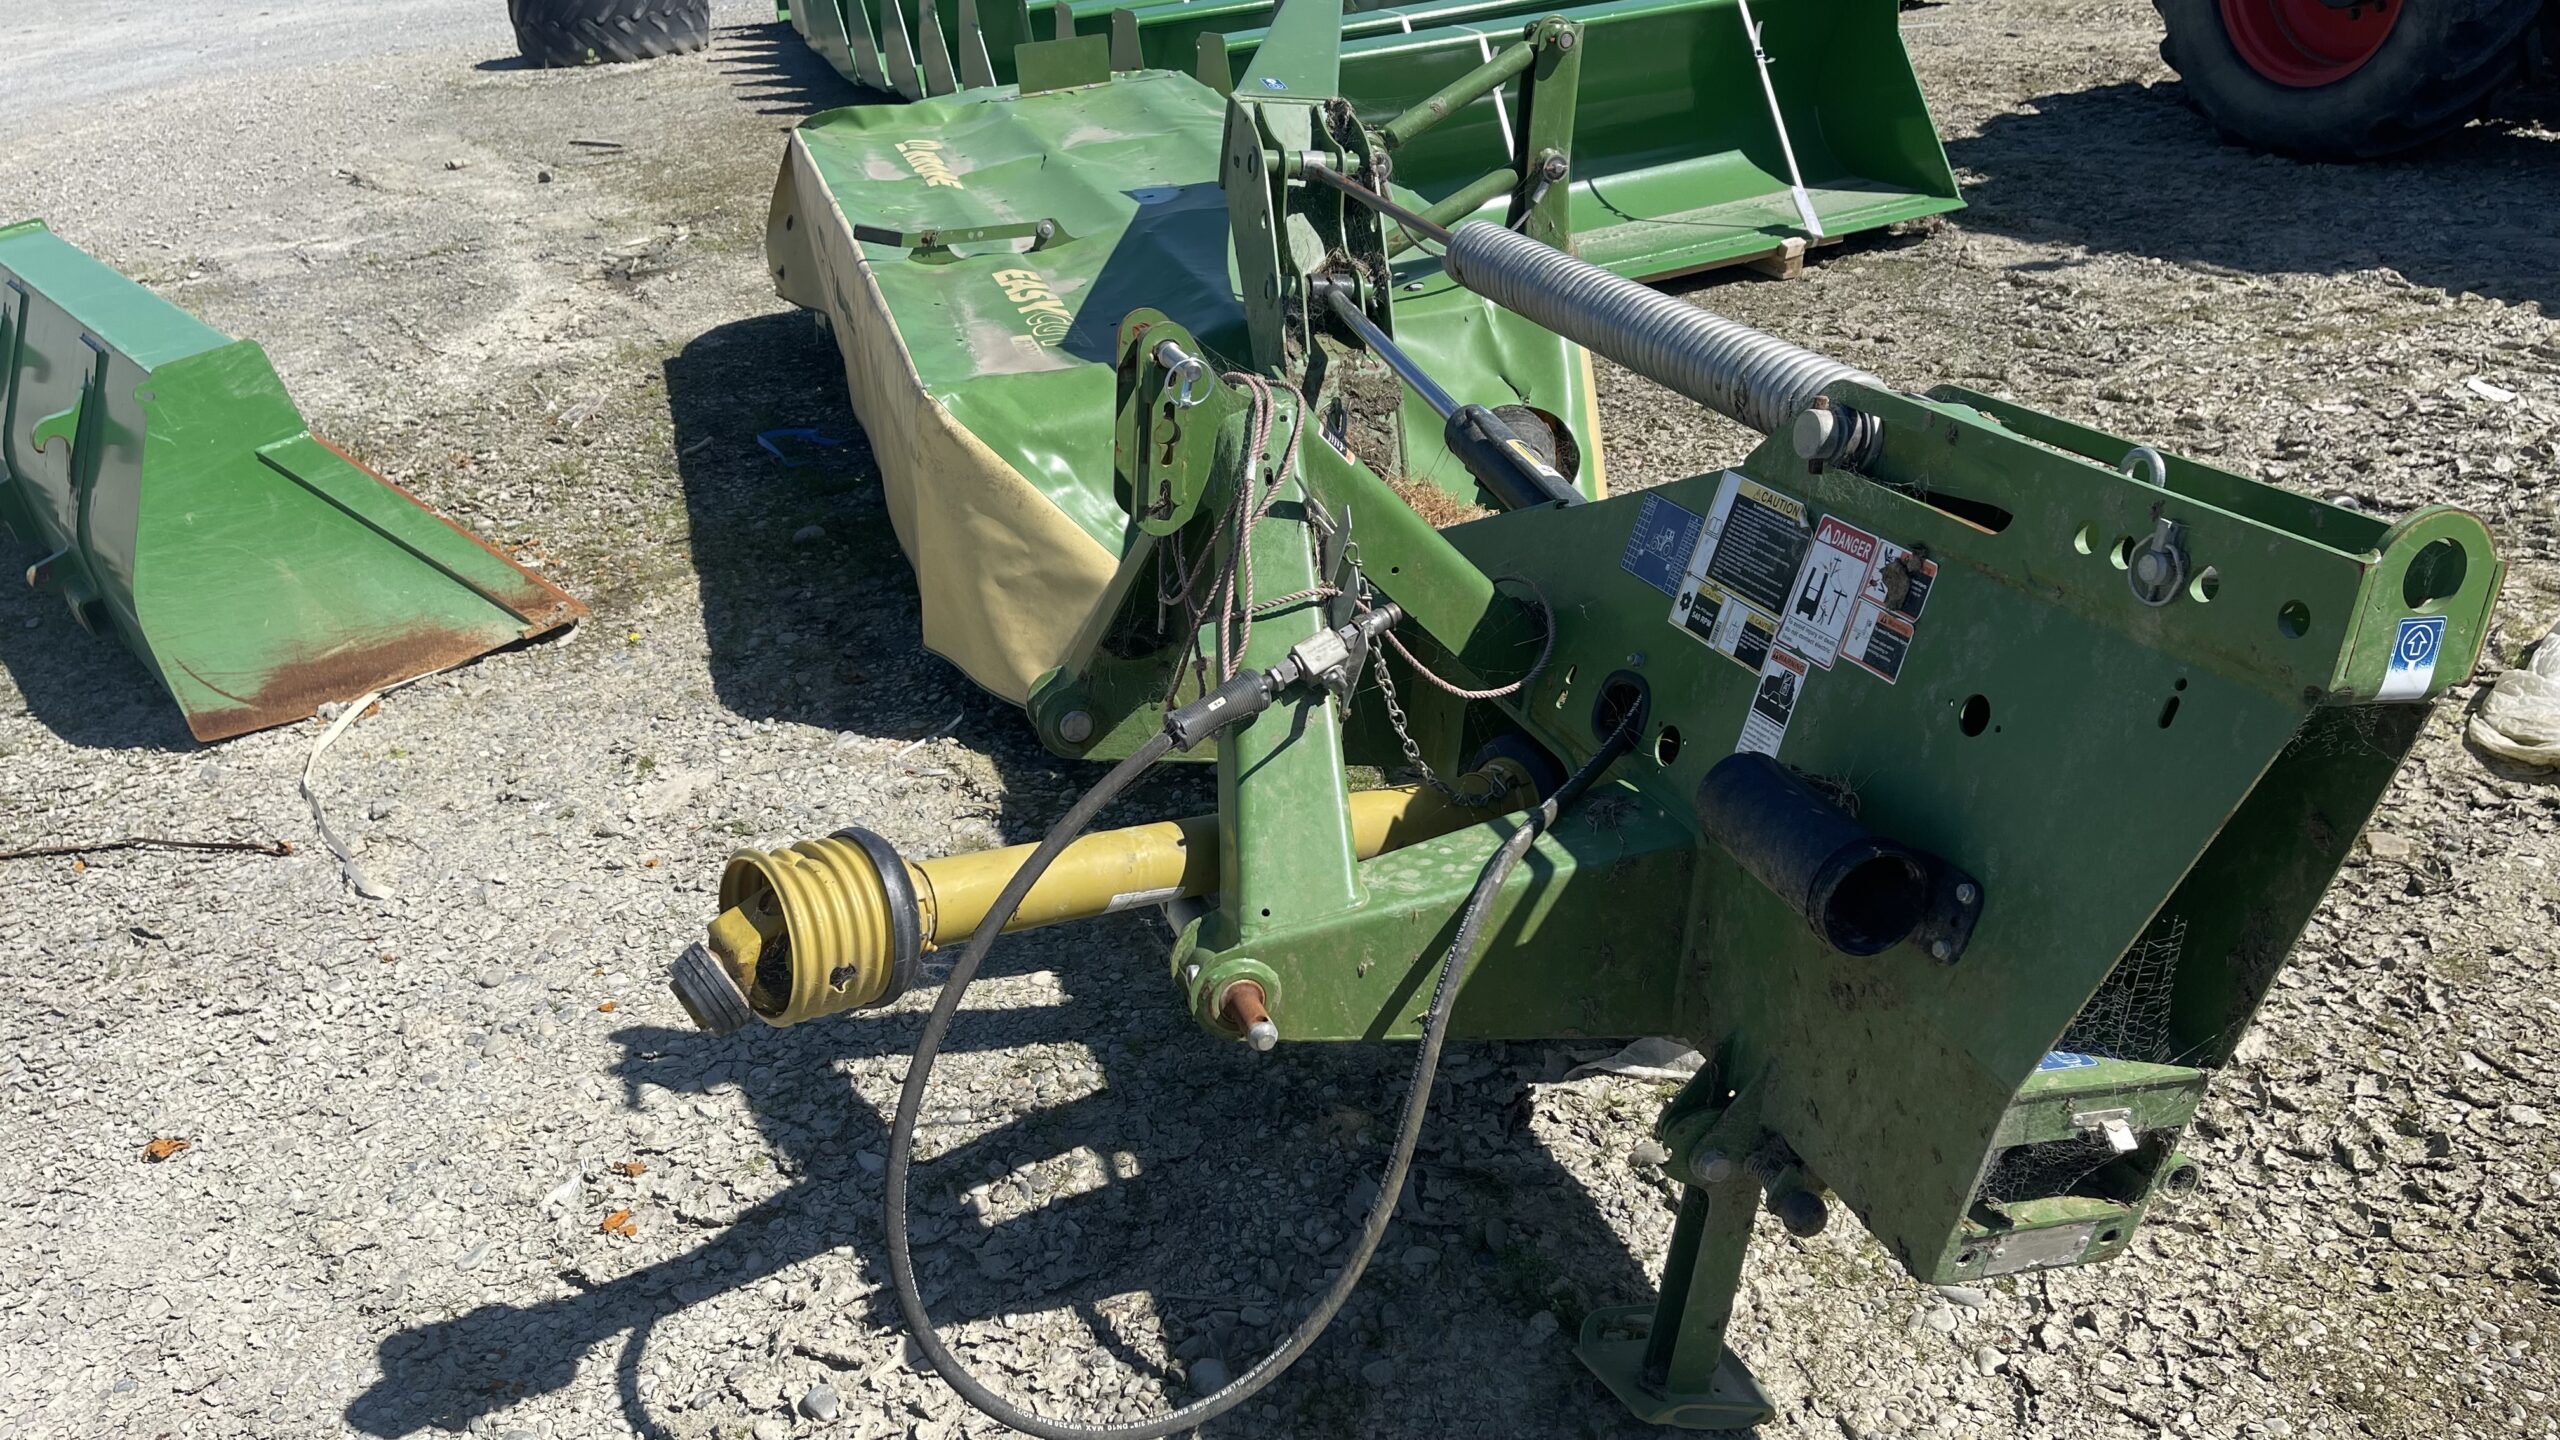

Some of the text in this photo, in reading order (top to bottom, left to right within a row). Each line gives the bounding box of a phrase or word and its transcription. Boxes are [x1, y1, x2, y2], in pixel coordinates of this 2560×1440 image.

[1761, 491, 1800, 518] CAUTION
[1831, 529, 1872, 560] DANGER
[1700, 614, 1713, 628] RPM
[1778, 653, 1806, 673] WARNING
[1254, 1337, 1293, 1372] HYDRAULIK
[1220, 1370, 1256, 1395] MUELLER
[1190, 1392, 1221, 1410] RHEINE
[1034, 1414, 1053, 1426] BAR
[1163, 1406, 1189, 1421] EN853
[1106, 1422, 1128, 1431] DN10
